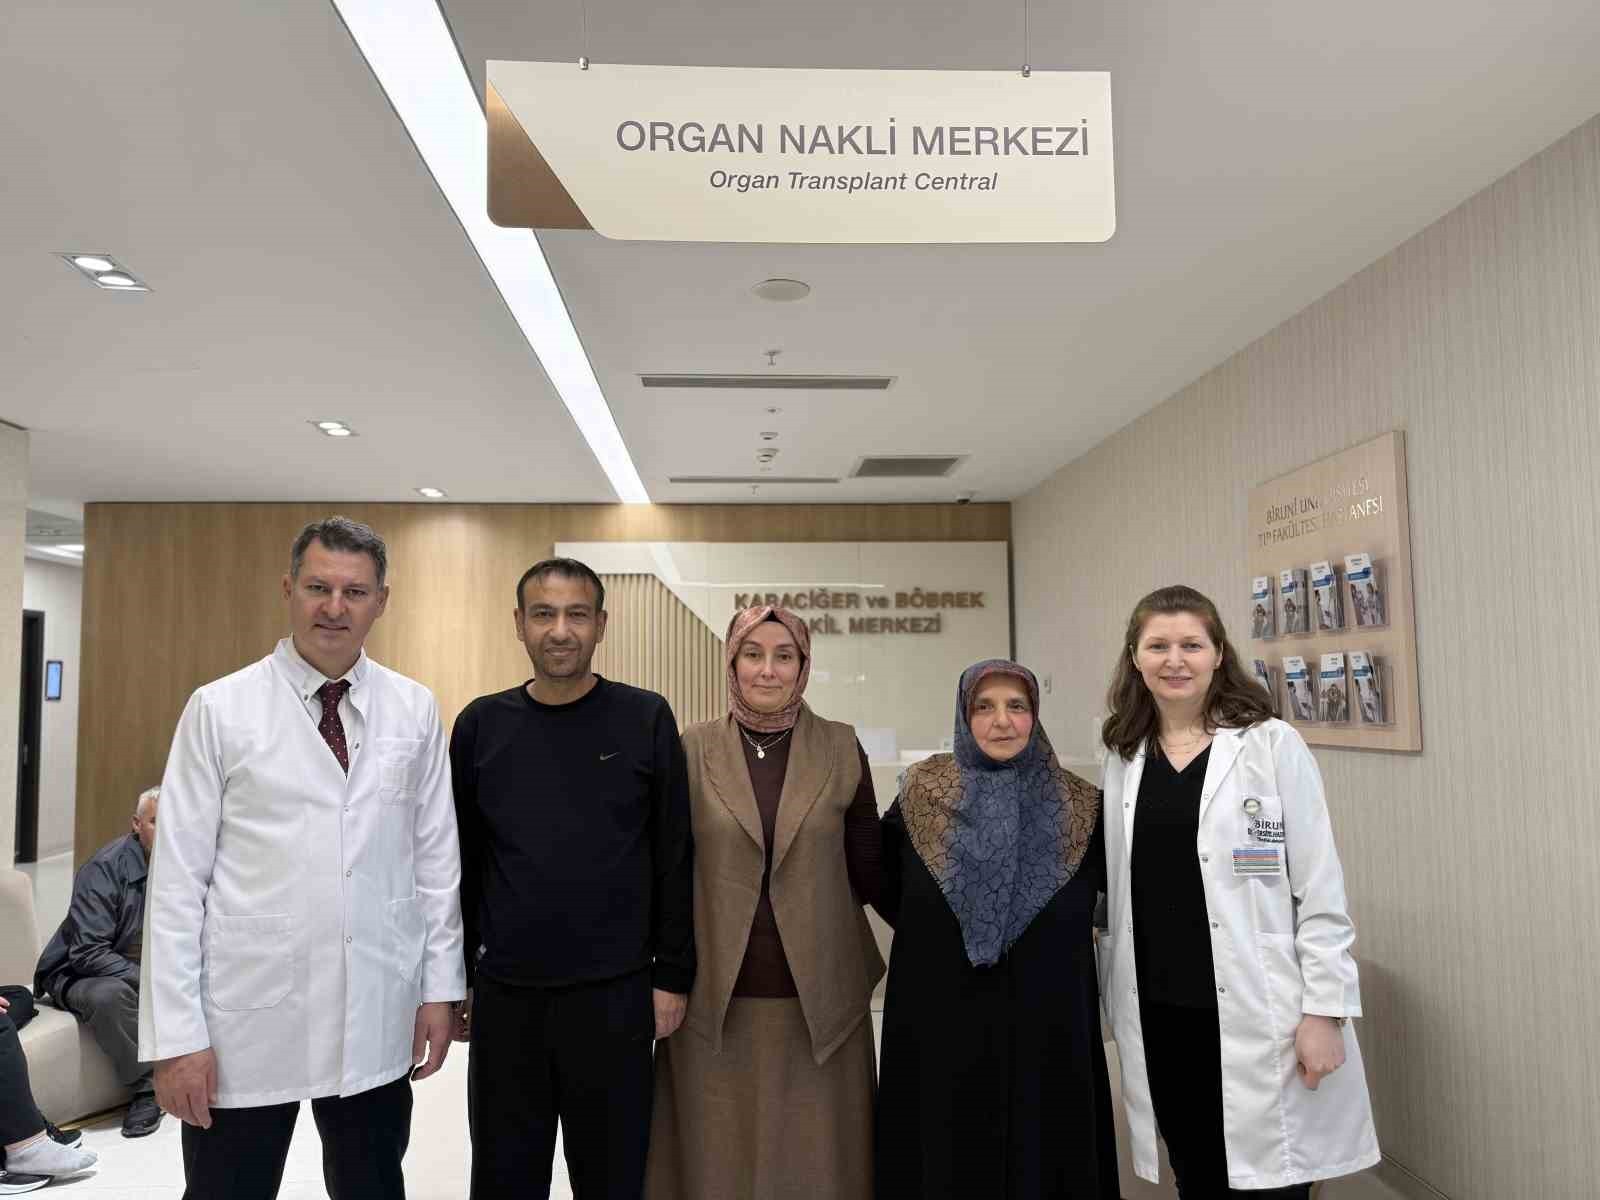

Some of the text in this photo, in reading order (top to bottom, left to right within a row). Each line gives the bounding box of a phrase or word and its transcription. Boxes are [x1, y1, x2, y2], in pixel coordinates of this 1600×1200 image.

[616, 117, 1089, 156] ORGAN NAKLİ MERKEZİ
[710, 170, 998, 194] Organ Transplant Central
[734, 587, 985, 610] KARACİĞER ve BÖBREK
[849, 613, 942, 635] MERKEZİ
